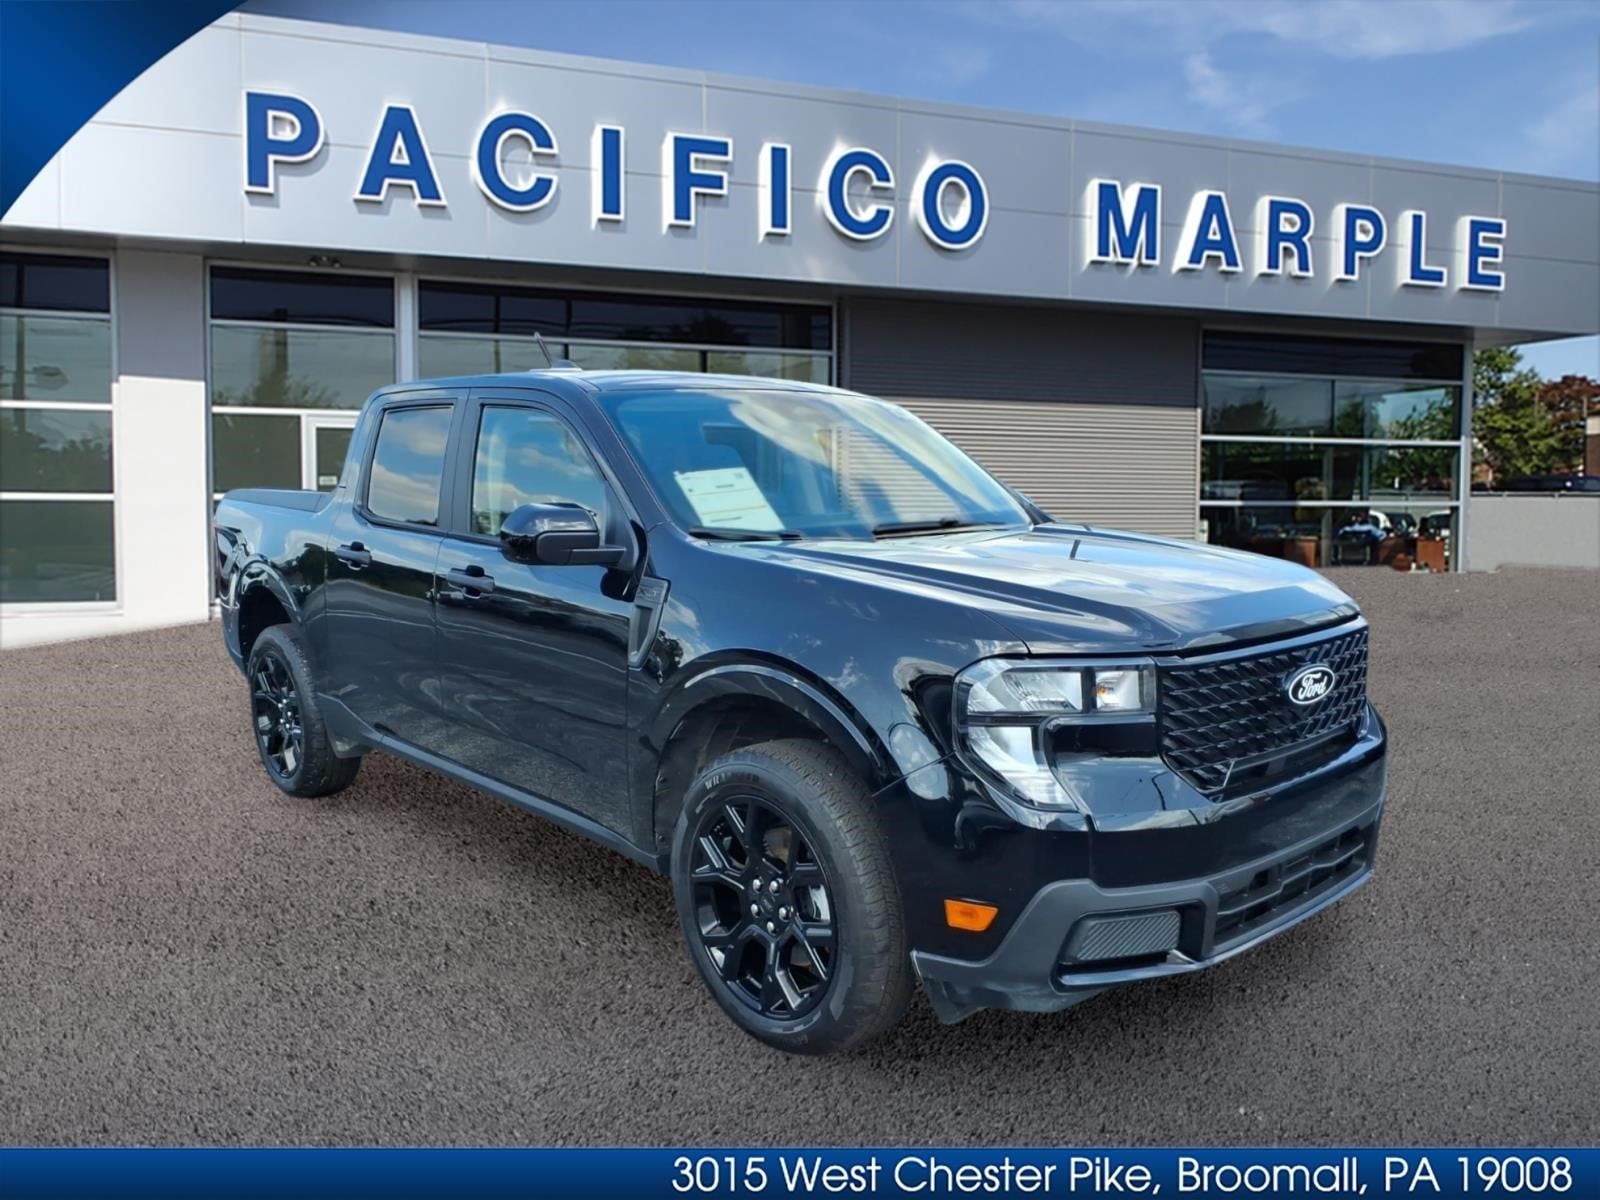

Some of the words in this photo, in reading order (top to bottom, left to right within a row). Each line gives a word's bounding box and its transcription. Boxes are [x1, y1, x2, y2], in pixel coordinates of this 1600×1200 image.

[243, 90, 989, 251] PACIFICO
[1088, 180, 1506, 291] MARPLE
[1298, 672, 1328, 700] Ford
